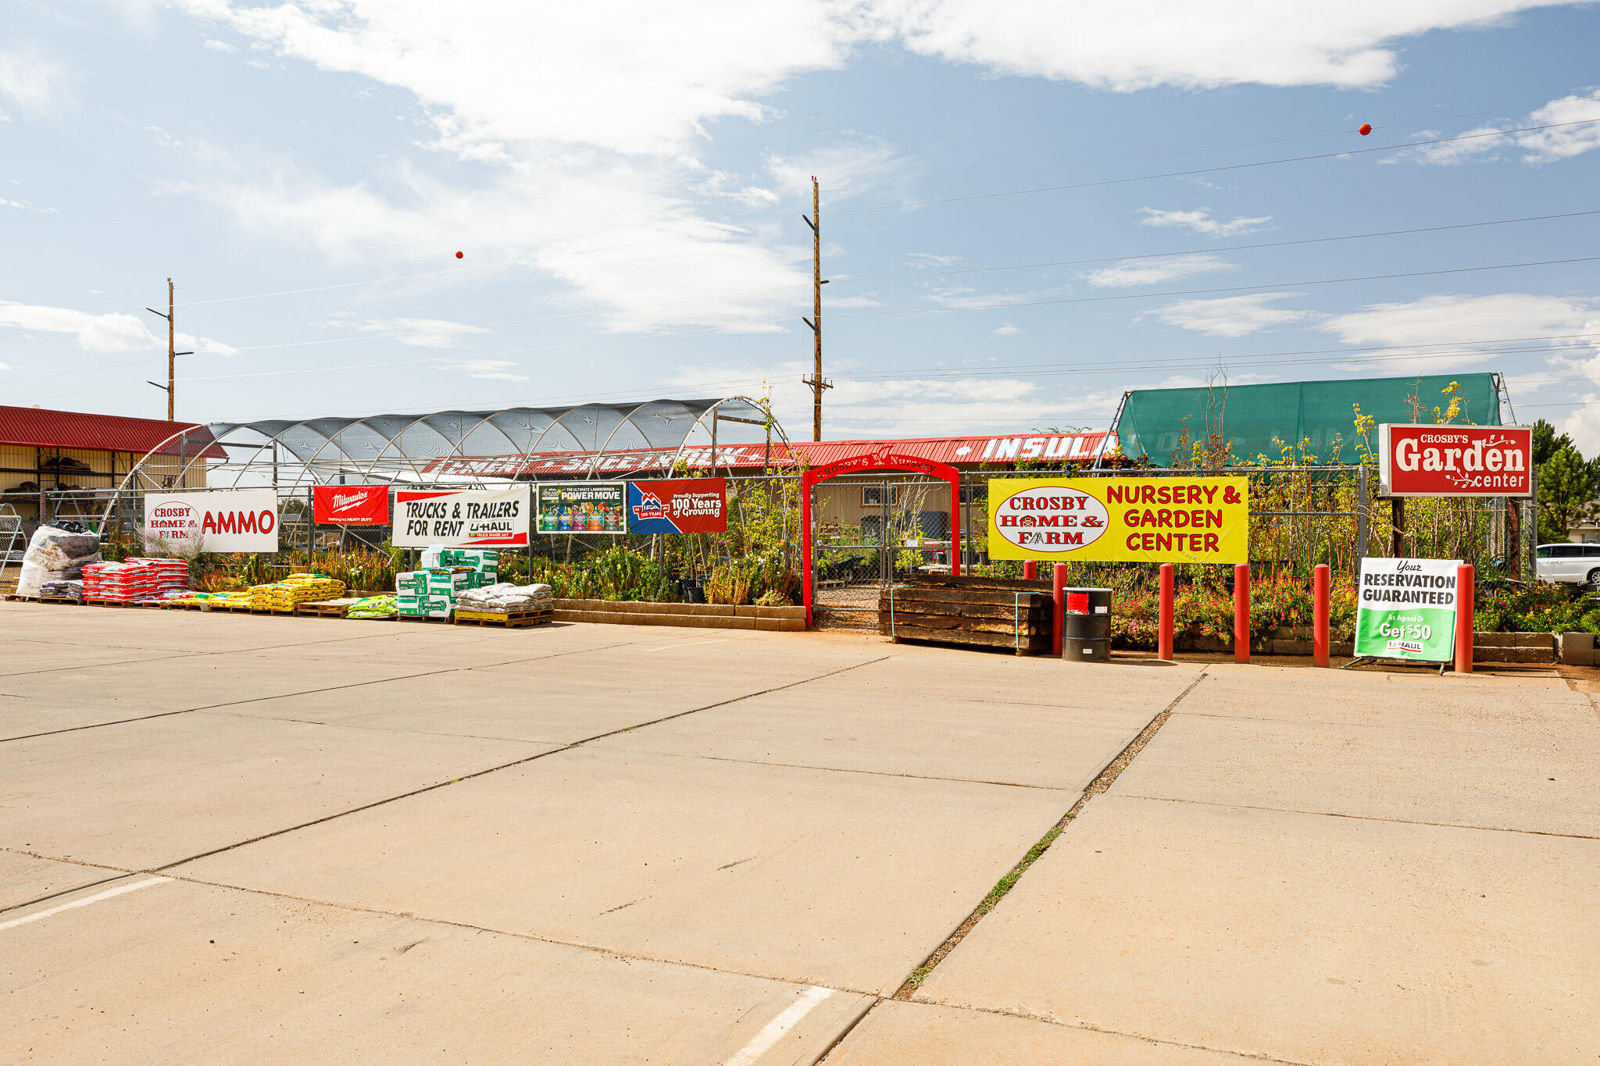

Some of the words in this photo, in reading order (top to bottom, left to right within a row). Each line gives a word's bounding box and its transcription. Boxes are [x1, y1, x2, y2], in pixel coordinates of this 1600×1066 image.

[1420, 434, 1469, 444] CROSBY'S
[1395, 438, 1525, 472] Garden
[817, 457, 869, 479] CROSBY'S
[1474, 473, 1524, 488] center
[561, 492, 594, 500] POWER
[594, 492, 620, 500] MOVE
[1106, 485, 1219, 505] NURSERY
[1222, 485, 1242, 504] &
[406, 502, 447, 519] TRUCKS
[452, 502, 461, 519] &
[466, 500, 520, 519] TRAILERS
[672, 498, 690, 510] 100
[691, 498, 722, 509] Years
[1009, 496, 1089, 511] CROSBY
[154, 508, 191, 517] CROSBY
[673, 509, 682, 518] of
[682, 508, 720, 517] Growing
[1123, 508, 1223, 529] GARDEN
[202, 510, 275, 535] AMMO
[406, 520, 428, 536] FOR
[433, 521, 464, 537] RENT
[1000, 514, 1078, 528] HOME
[1080, 515, 1105, 528] &
[1017, 531, 1084, 545] FARM
[1126, 532, 1219, 552] CENTER
[1397, 560, 1422, 573] Your
[1364, 573, 1456, 589] RESERVATION
[1363, 589, 1454, 605] GUARANTEED
[1380, 622, 1406, 638] Get
[1408, 624, 1432, 640] $50
